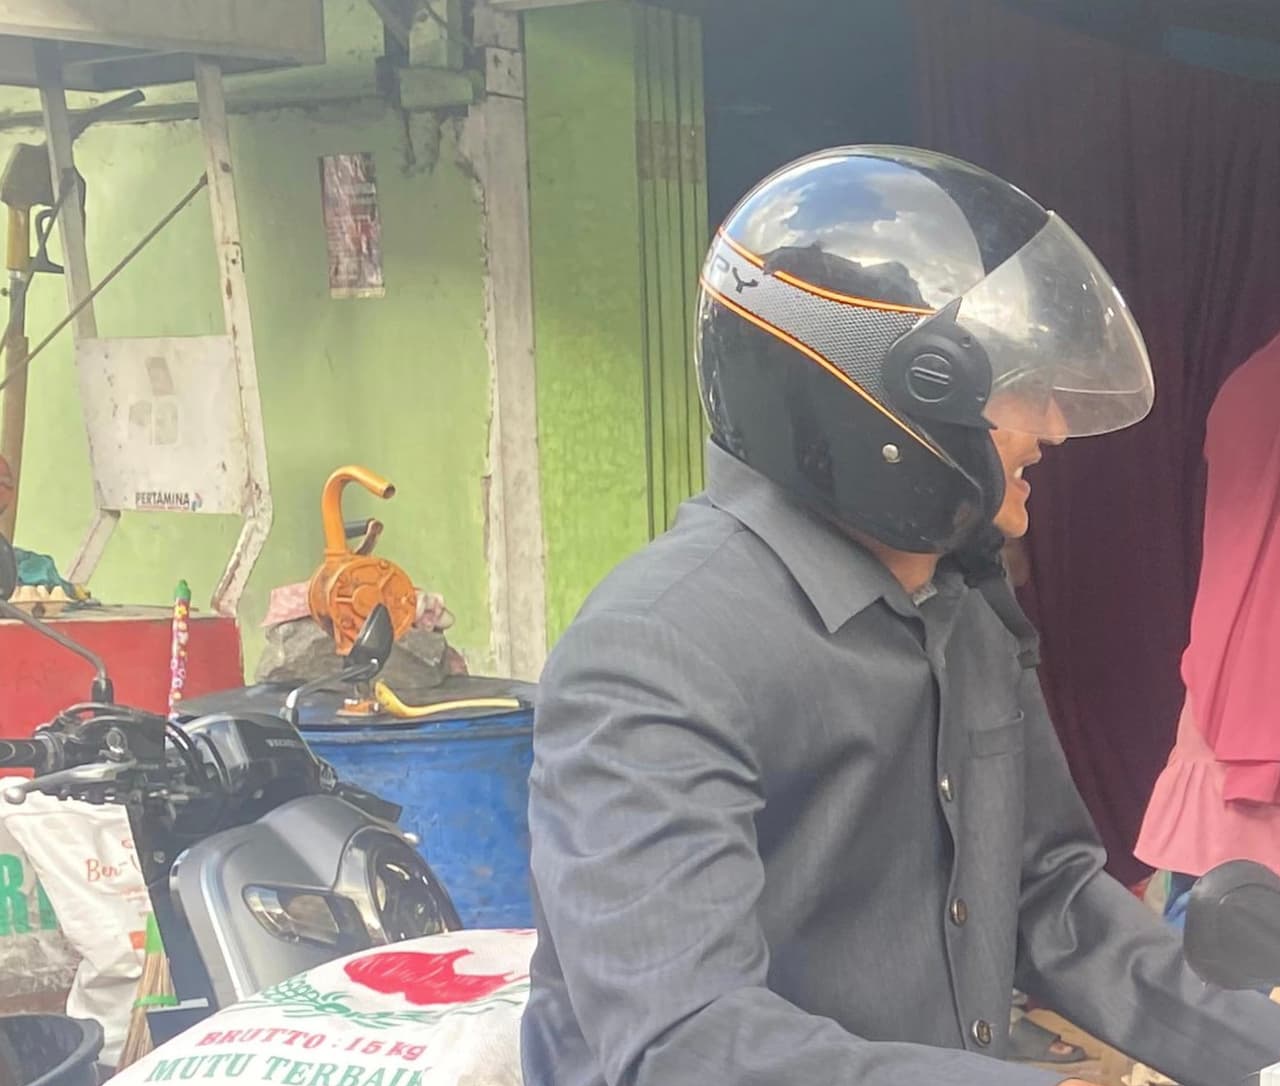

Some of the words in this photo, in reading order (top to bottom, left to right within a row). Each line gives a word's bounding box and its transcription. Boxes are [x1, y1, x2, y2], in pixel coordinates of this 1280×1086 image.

[135, 491, 190, 505] PERTAMINA
[195, 1027, 326, 1049] BRUTTO
[144, 1053, 257, 1083] MUTU
